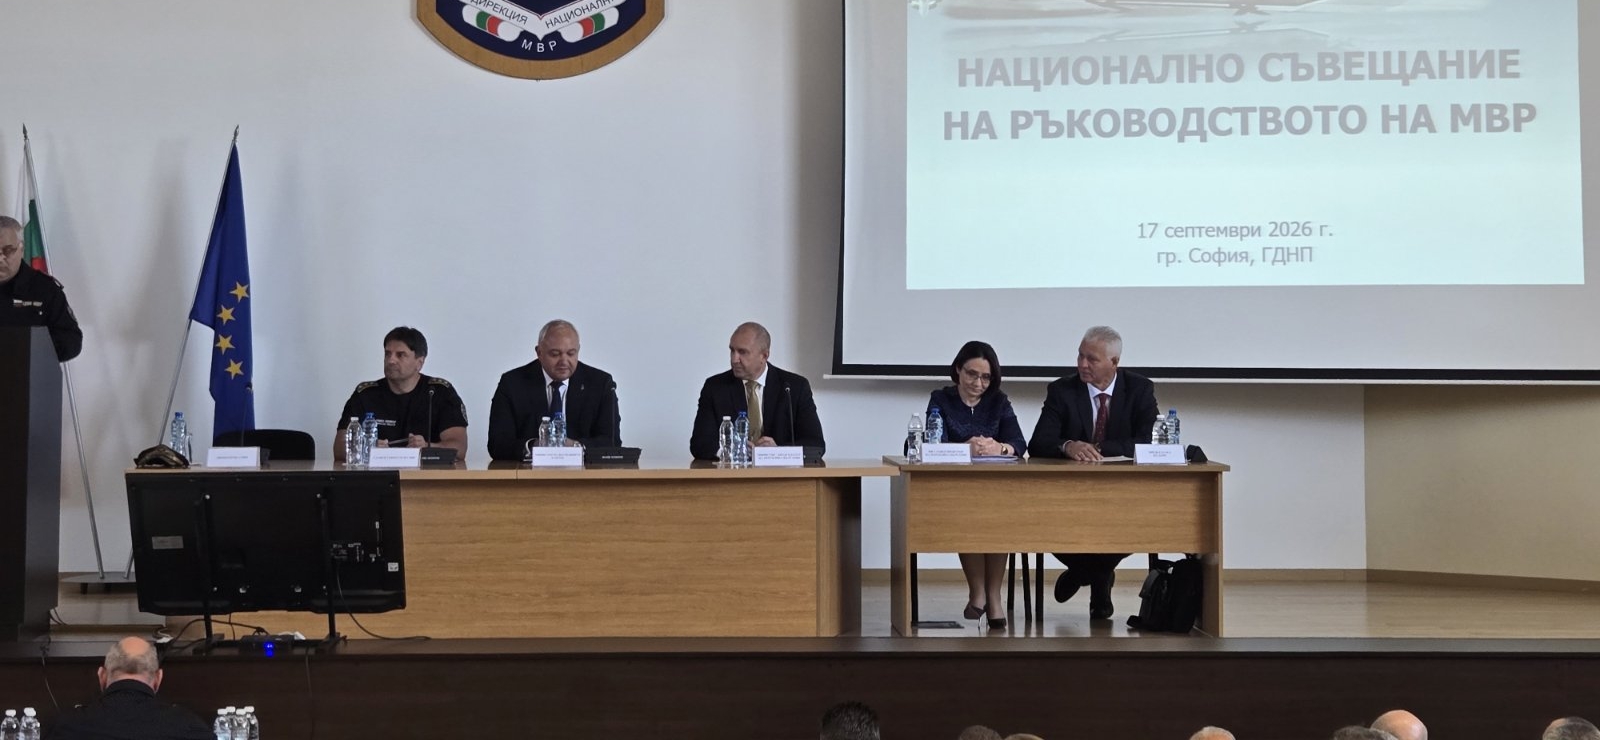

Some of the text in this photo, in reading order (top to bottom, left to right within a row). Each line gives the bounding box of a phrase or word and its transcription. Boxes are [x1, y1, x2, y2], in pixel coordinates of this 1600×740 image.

[545, 0, 614, 29] НАЦИОНАЛН
[521, 39, 557, 53] МВР
[957, 49, 1520, 91] НАЦИОНАЛНО СЪВЕЩАНИЕ
[943, 103, 1537, 143] НА РЪКОВОДСТВОТО НА МВР
[1137, 220, 1333, 241] 17 септември 2026 г.
[1156, 246, 1313, 268] гр. София, ГДНП
